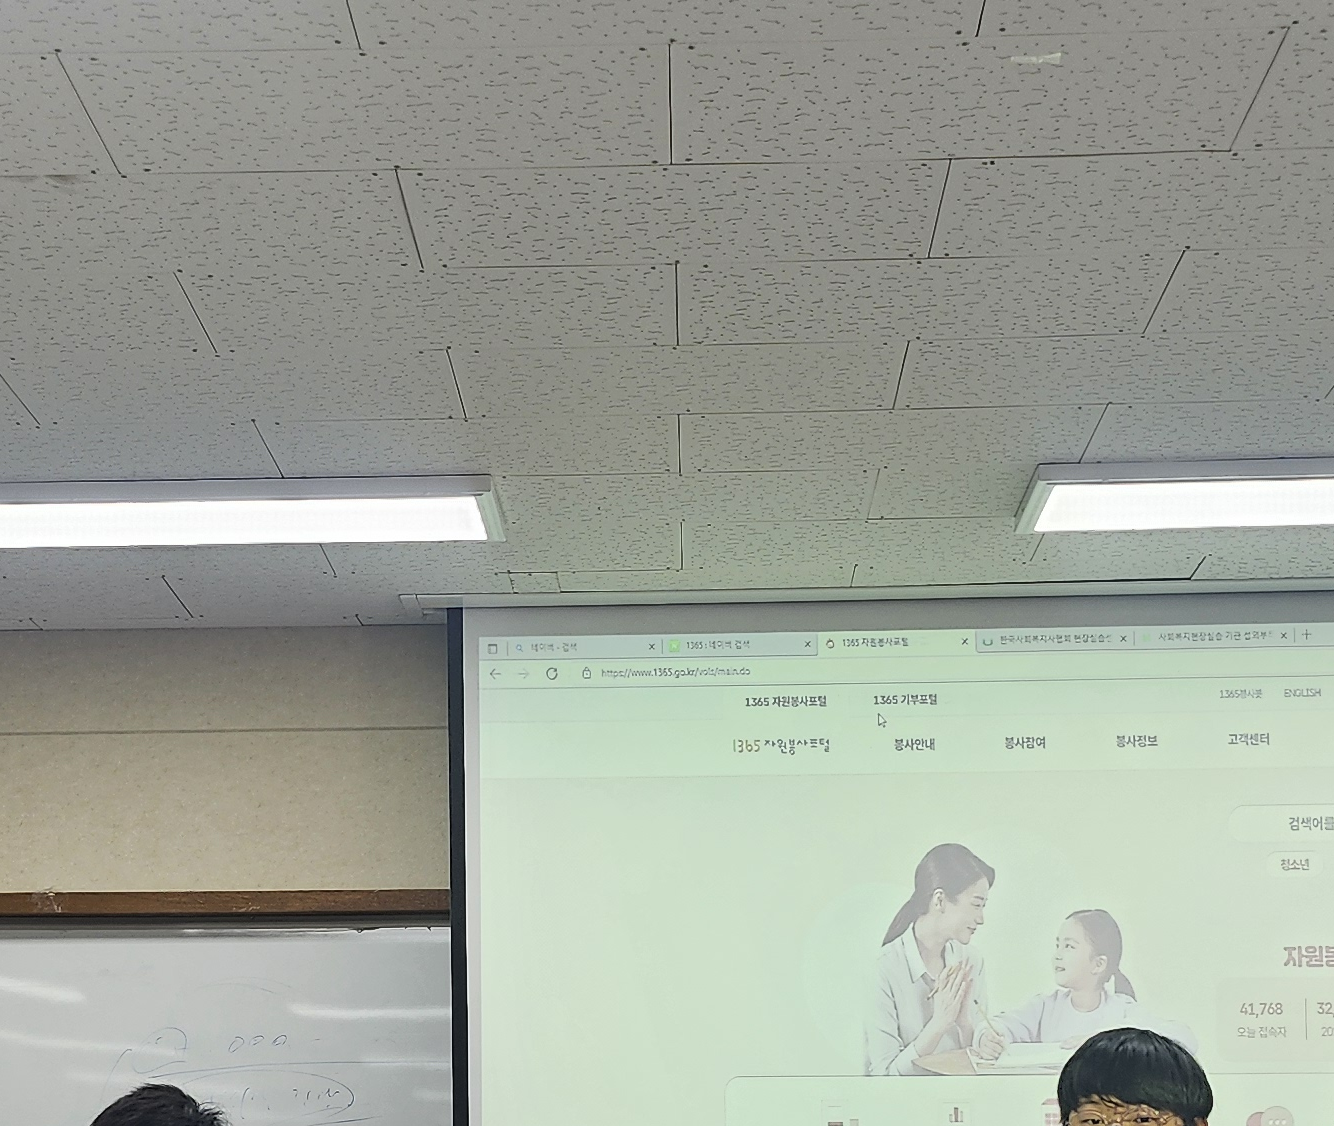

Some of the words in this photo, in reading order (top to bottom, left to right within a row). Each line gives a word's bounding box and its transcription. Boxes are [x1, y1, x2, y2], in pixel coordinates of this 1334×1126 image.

[842, 638, 860, 647] 1365
[861, 637, 909, 647] 자원봉사포털
[1284, 688, 1322, 698] ENGLISH
[745, 697, 770, 707] 1365
[771, 696, 828, 708] 자원봉사포털
[873, 695, 899, 705] 1365
[900, 694, 938, 706] 기부포털
[894, 737, 936, 751] 봉사안내
[1004, 735, 1047, 750] 봉사참여
[1116, 734, 1159, 748] 봉사정보
[1228, 732, 1271, 746] 고객센터
[732, 739, 761, 753] 1365
[764, 738, 830, 755] 자원봉사포털
[1280, 858, 1310, 871] 청소년
[1239, 1002, 1284, 1018] 41,768
[1237, 1026, 1257, 1039] 오늘
